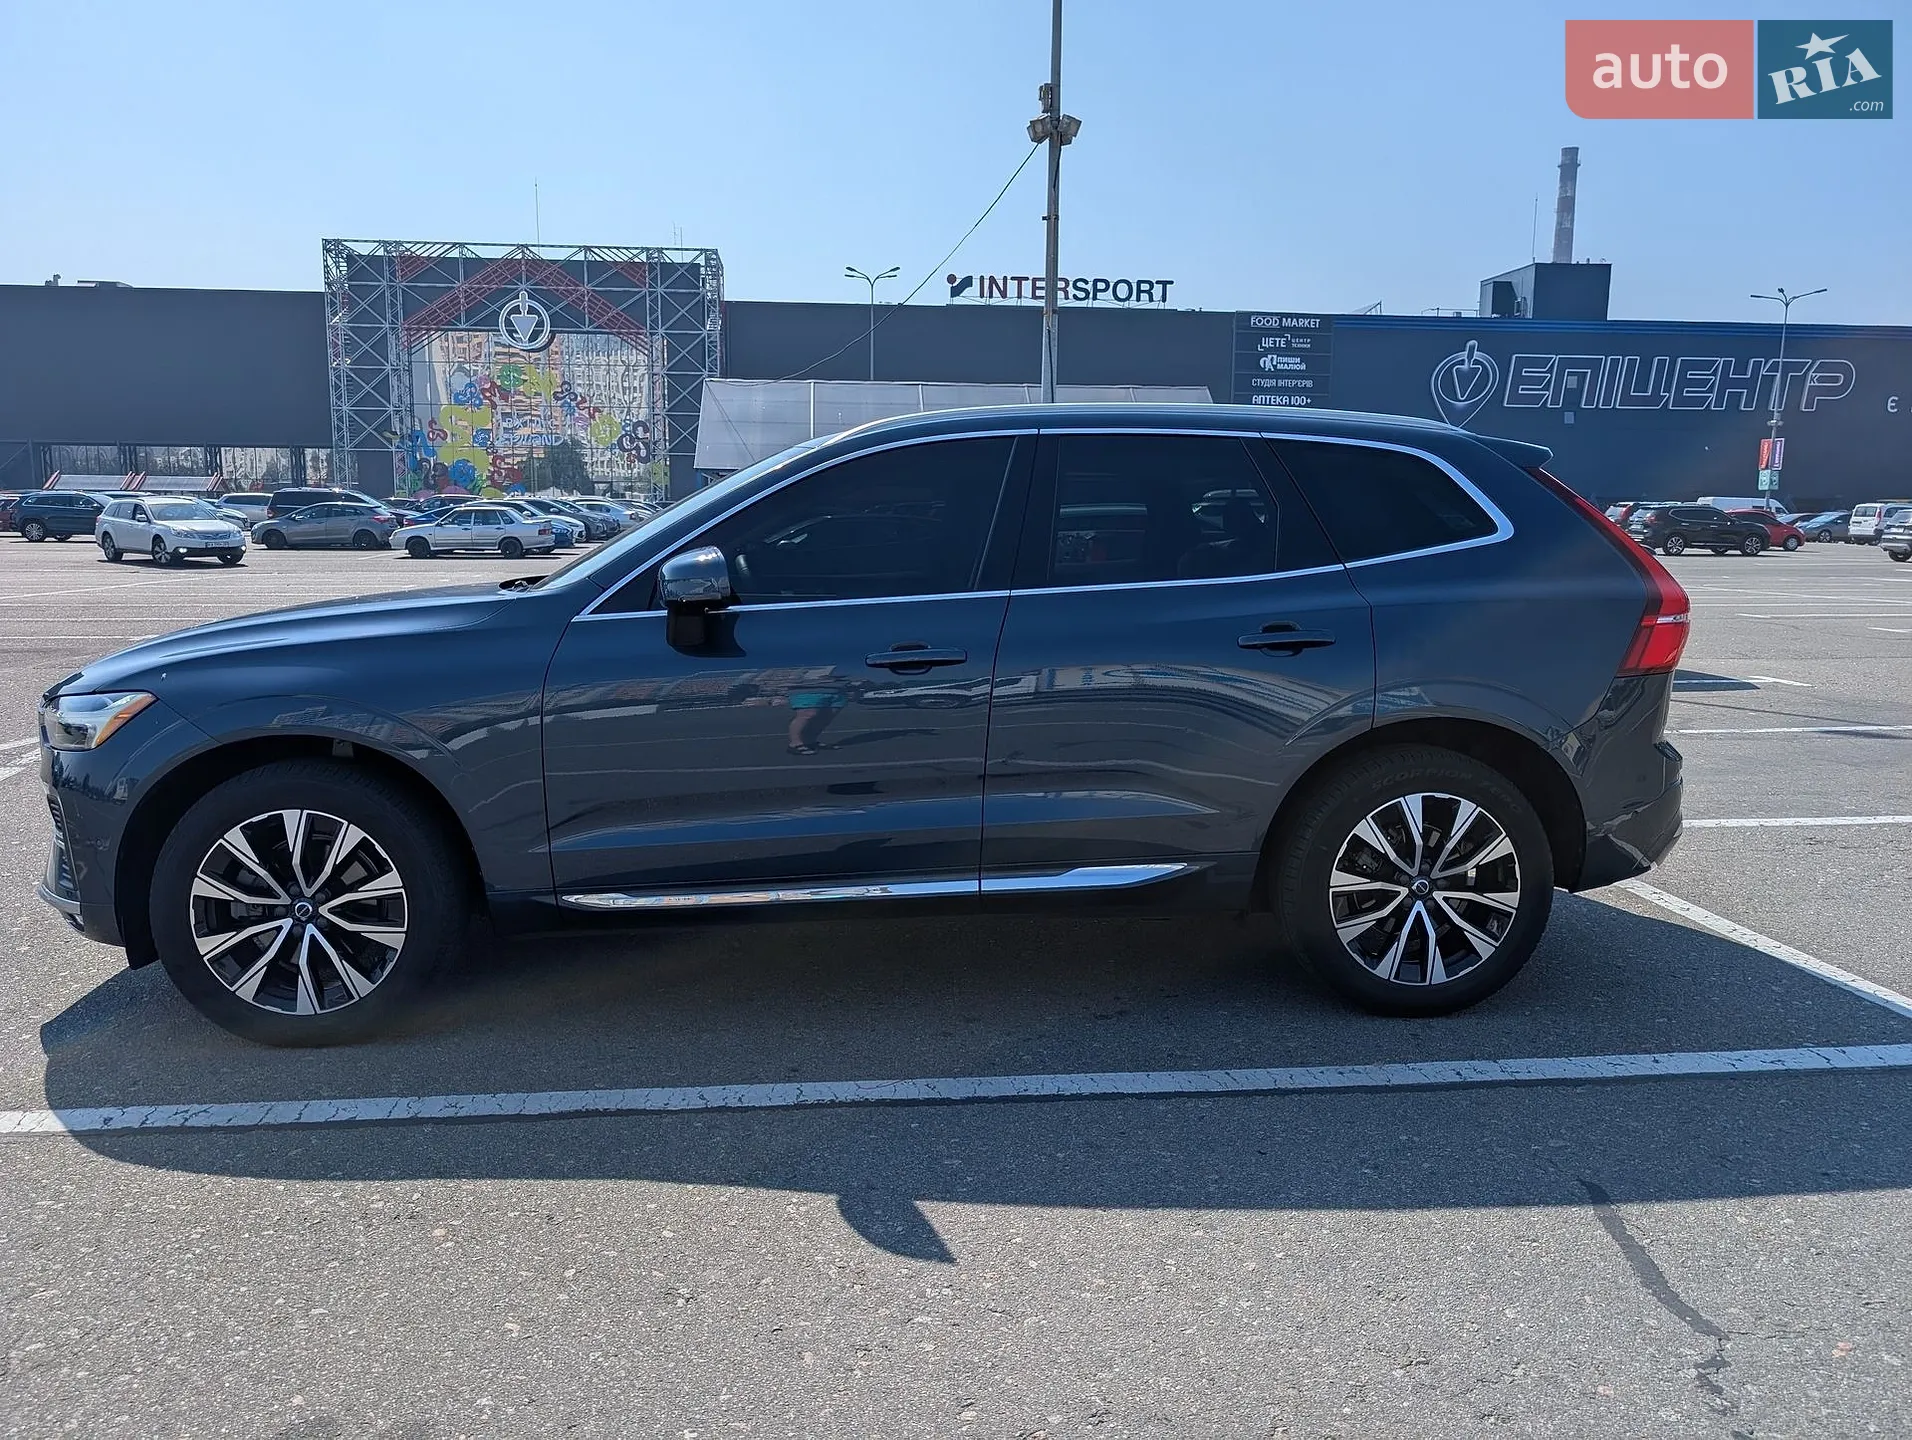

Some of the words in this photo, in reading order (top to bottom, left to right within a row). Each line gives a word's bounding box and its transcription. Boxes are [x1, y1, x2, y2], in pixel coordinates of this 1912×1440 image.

[979, 275, 1175, 303] INTERSPORT
[1251, 317, 1280, 328] FOOD
[1282, 318, 1320, 328] MARKET
[1262, 337, 1287, 348] ЦЕТЕ
[1277, 362, 1306, 370] МАЛЮЙ
[1251, 378, 1277, 388] СТУДІЯ
[1503, 354, 1856, 411] ЕПІЦЕНТР
[1252, 395, 1289, 405] АПТЕКА
